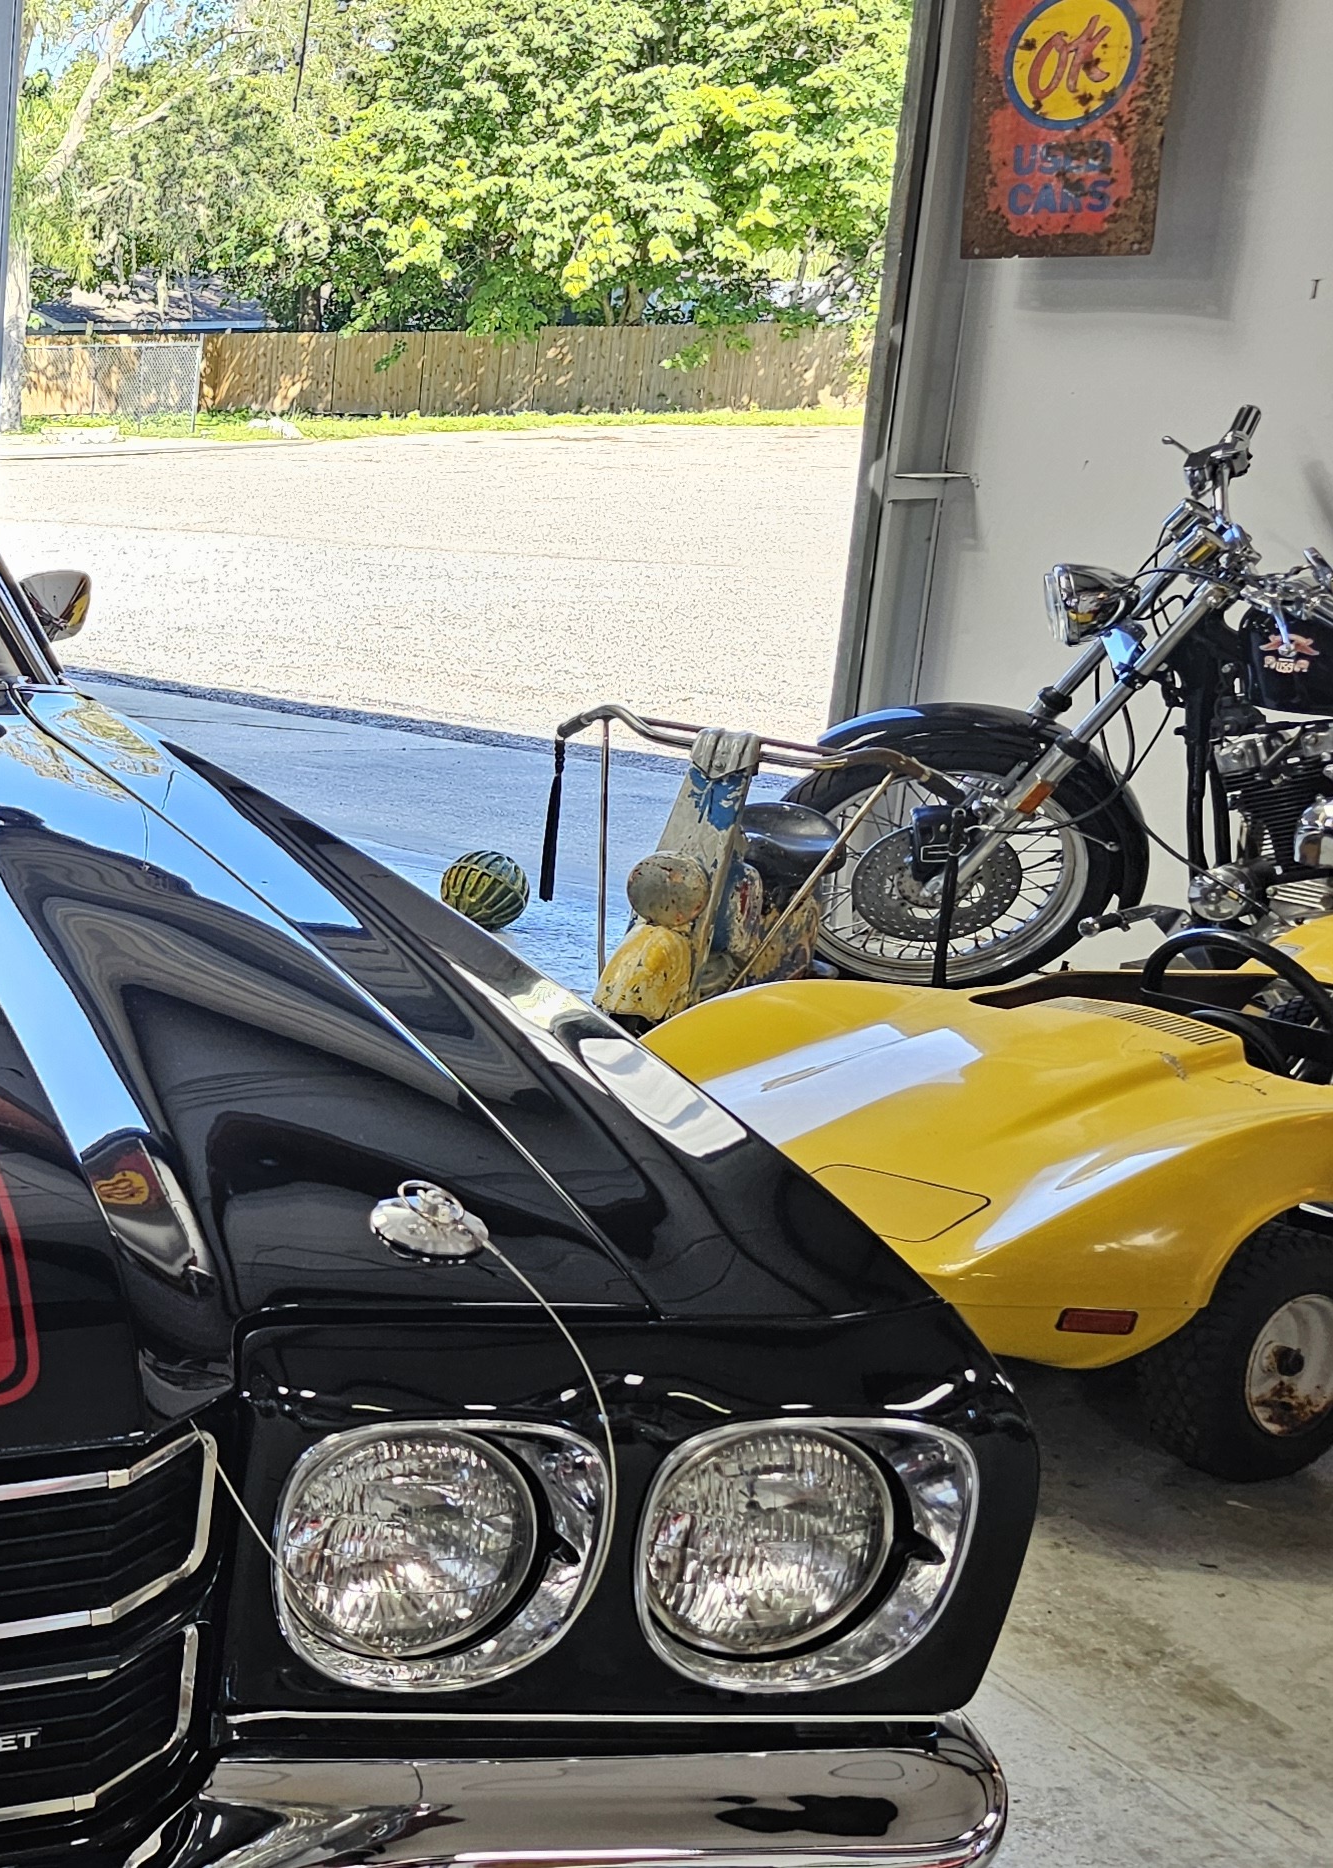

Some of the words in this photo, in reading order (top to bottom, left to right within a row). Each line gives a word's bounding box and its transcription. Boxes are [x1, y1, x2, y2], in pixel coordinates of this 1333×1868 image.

[1027, 14, 1112, 101] OK
[1013, 141, 1113, 175] USED
[1008, 178, 1112, 216] CARS
